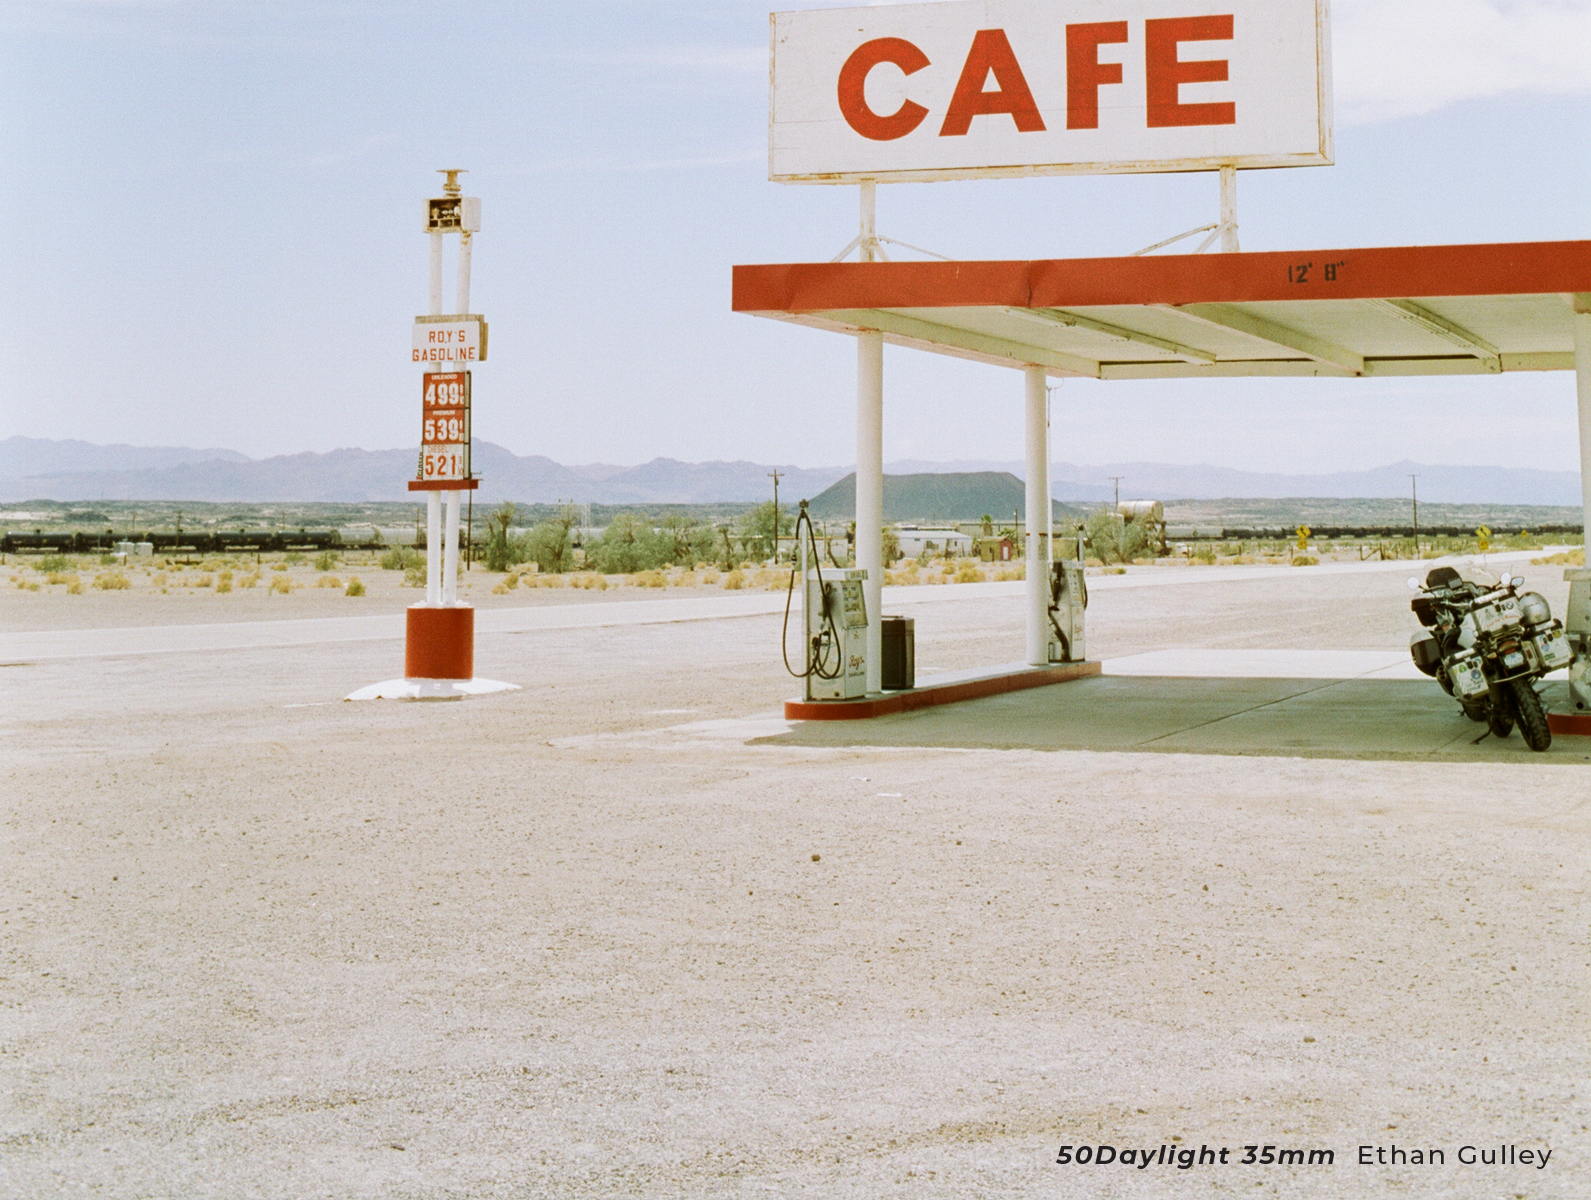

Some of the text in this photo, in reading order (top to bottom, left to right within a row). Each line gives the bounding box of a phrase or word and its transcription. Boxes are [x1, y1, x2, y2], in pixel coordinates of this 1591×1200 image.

[836, 13, 1237, 142] CAFE
[428, 329, 466, 343] ROY'S
[412, 346, 476, 362] GASOLINE
[427, 445, 449, 454] DIESEL
